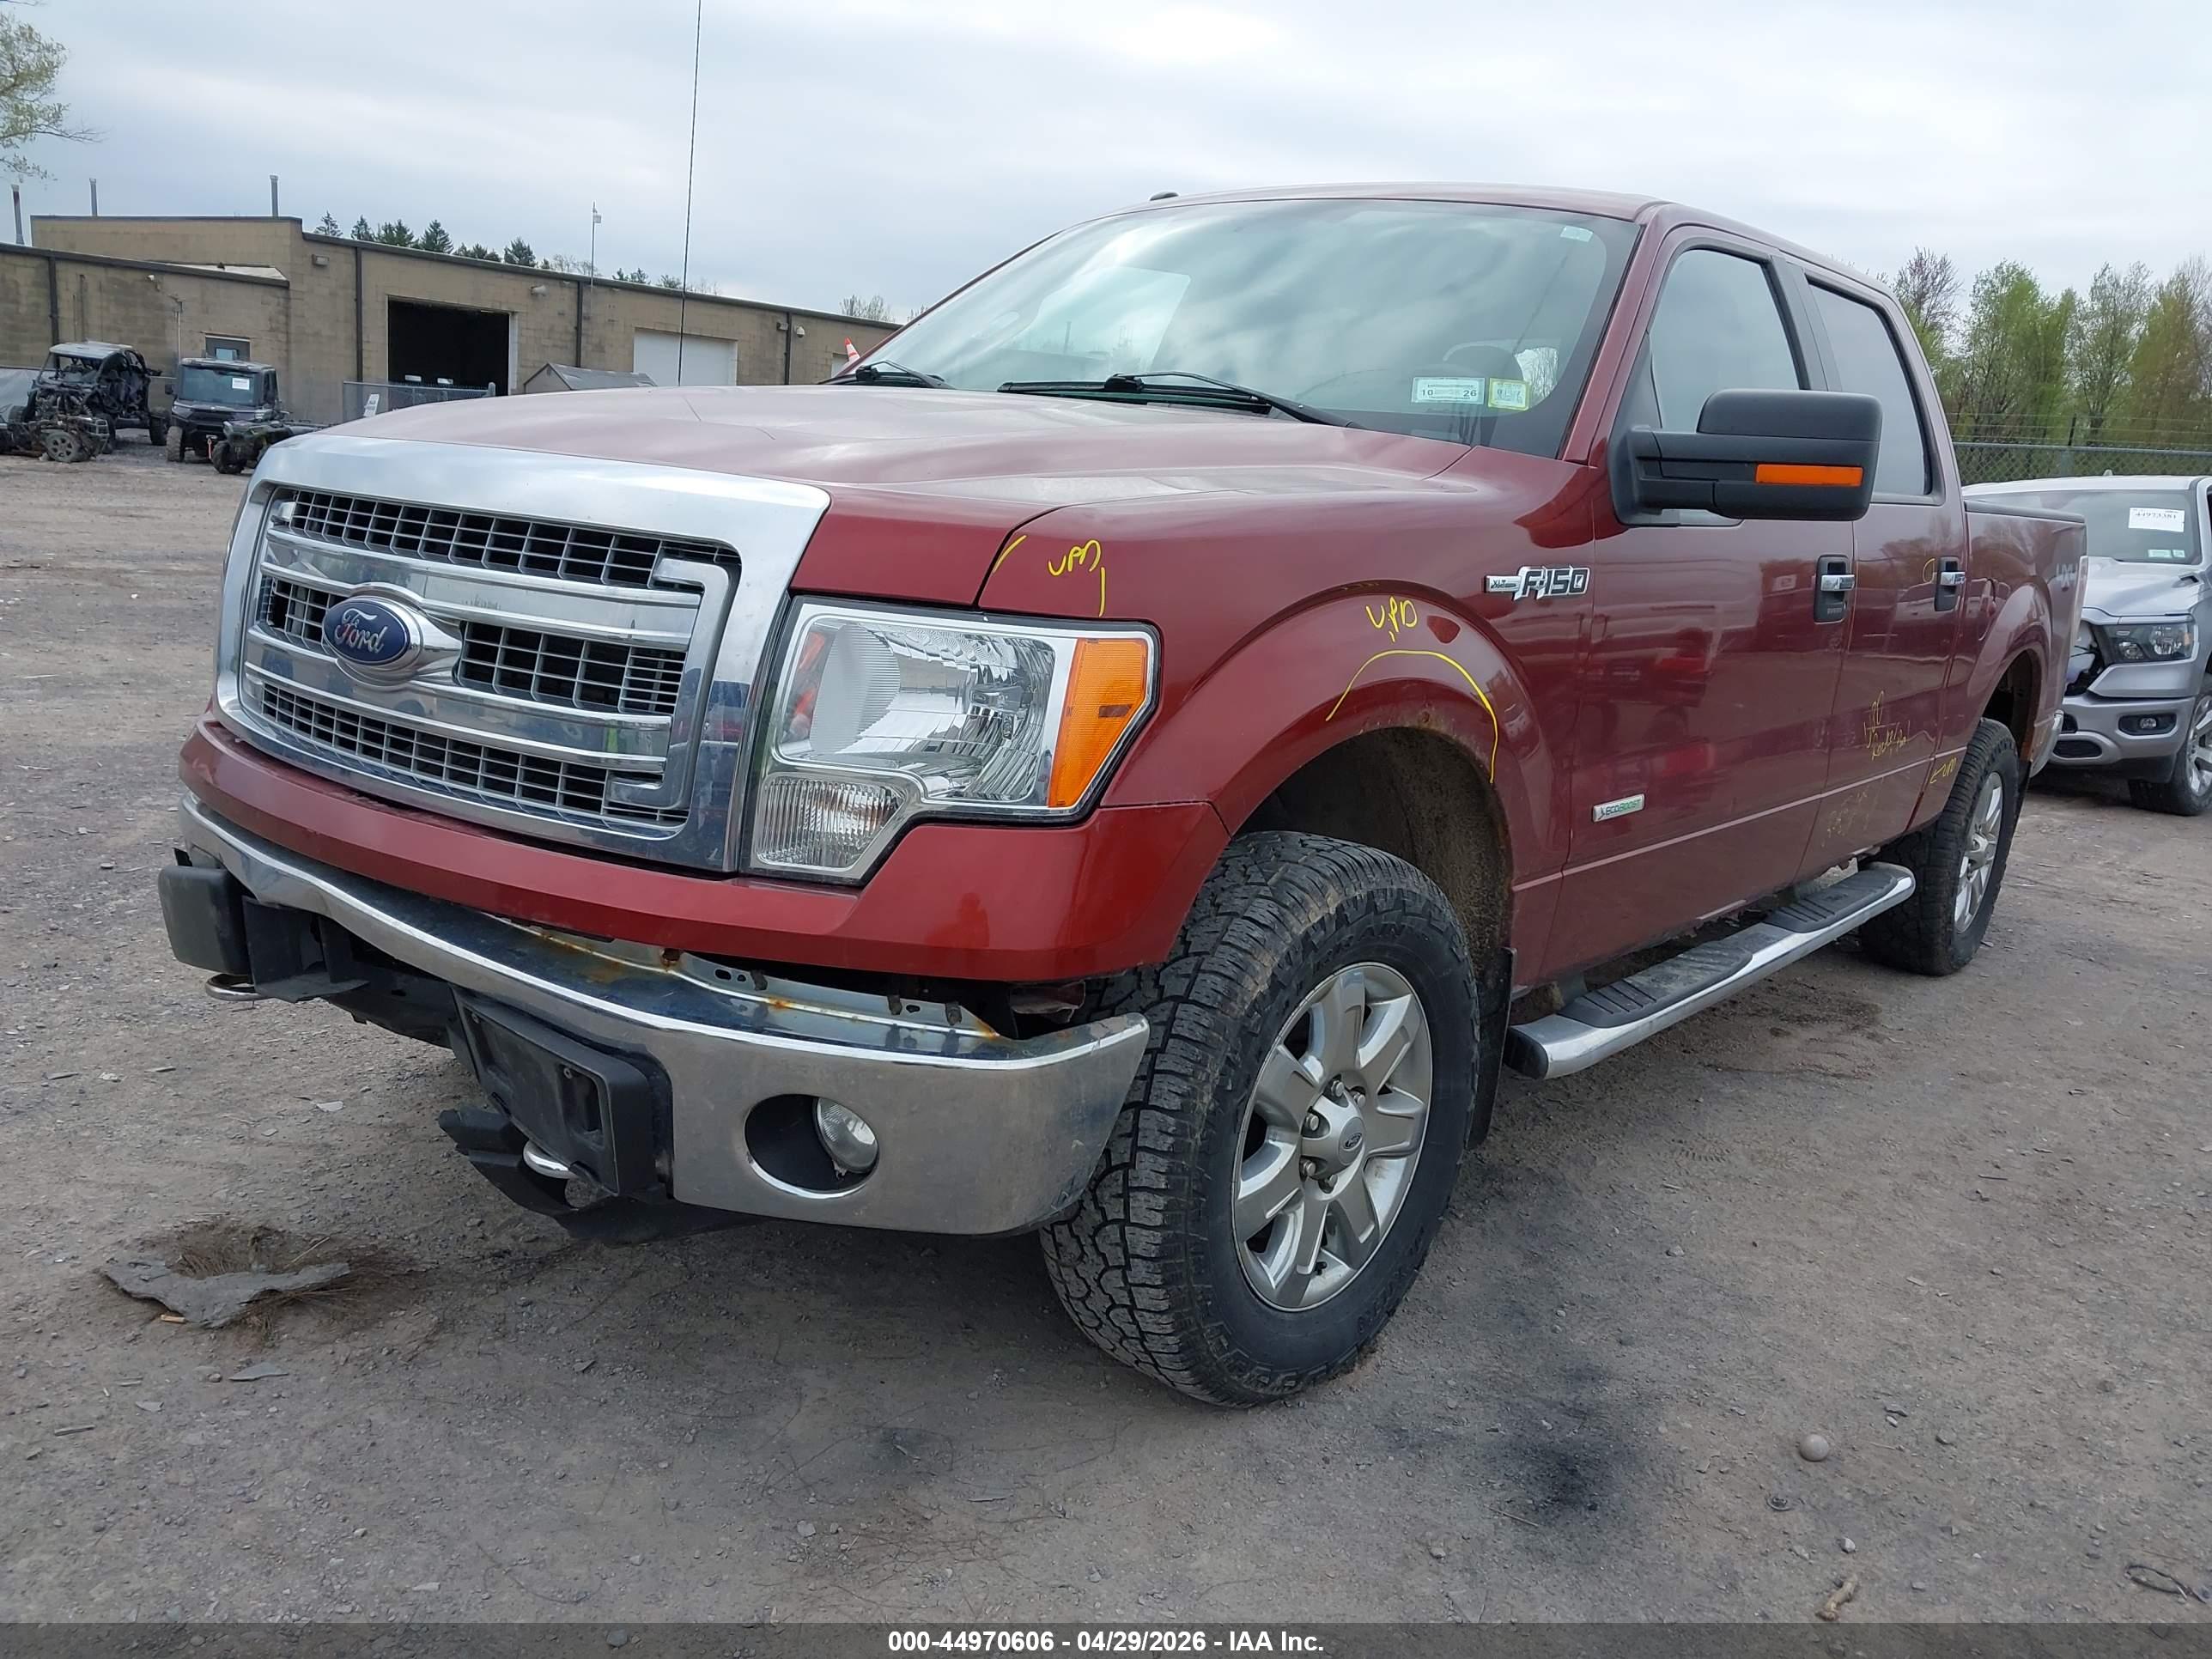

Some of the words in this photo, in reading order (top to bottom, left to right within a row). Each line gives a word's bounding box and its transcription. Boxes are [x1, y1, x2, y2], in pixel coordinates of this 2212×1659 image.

[1421, 388, 1434, 397] 10
[1462, 388, 1478, 398] 26
[1519, 566, 1589, 599] F-150
[333, 607, 388, 653] Ford
